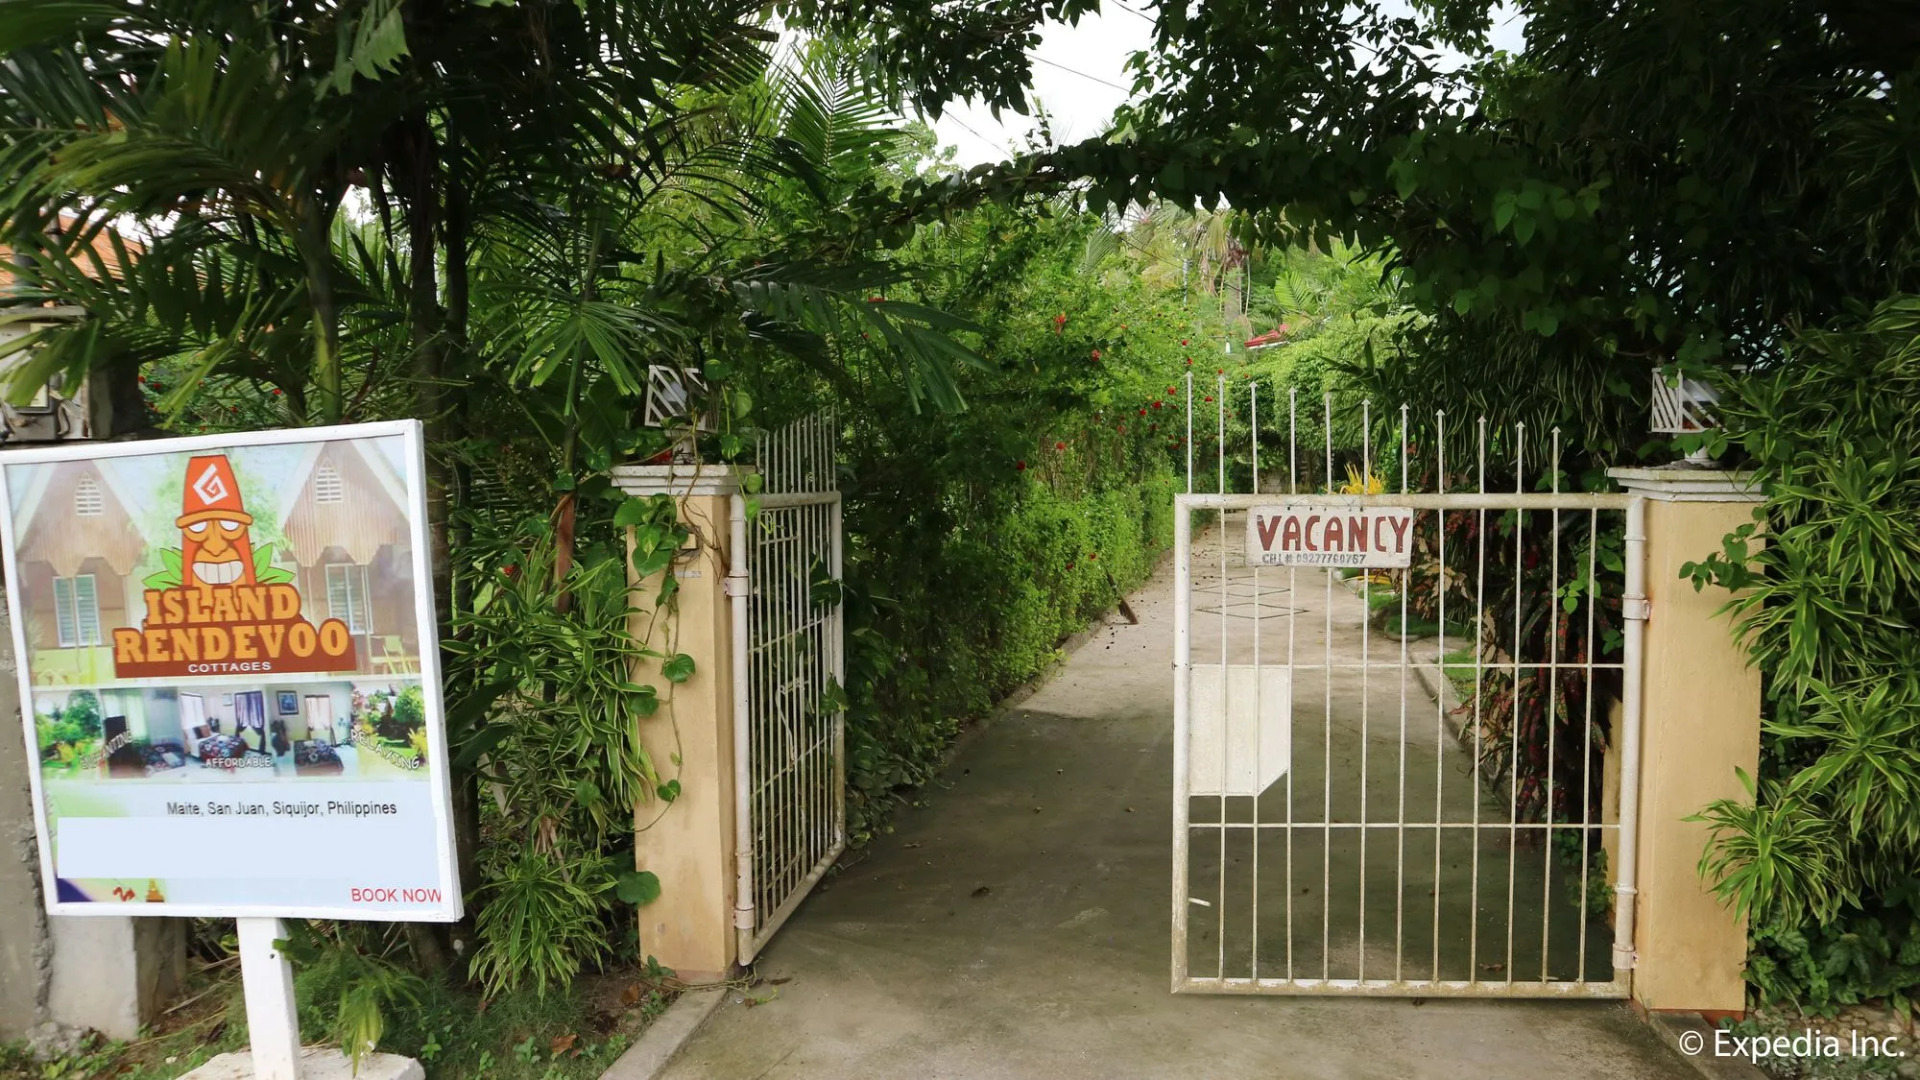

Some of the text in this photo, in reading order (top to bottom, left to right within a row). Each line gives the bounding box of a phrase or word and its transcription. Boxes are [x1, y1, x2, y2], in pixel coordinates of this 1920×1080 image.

[1256, 514, 1411, 553] VACANCY
[144, 583, 300, 625] ISLAND
[114, 619, 349, 664] RENDEVOO
[187, 661, 272, 674] COTTAGES
[205, 757, 272, 768] AFFORDABLE
[350, 728, 420, 770] RELAXING
[166, 800, 398, 818] Maite, San Juan, Siquijor, Philippines
[351, 888, 442, 902] BOOK NOW
